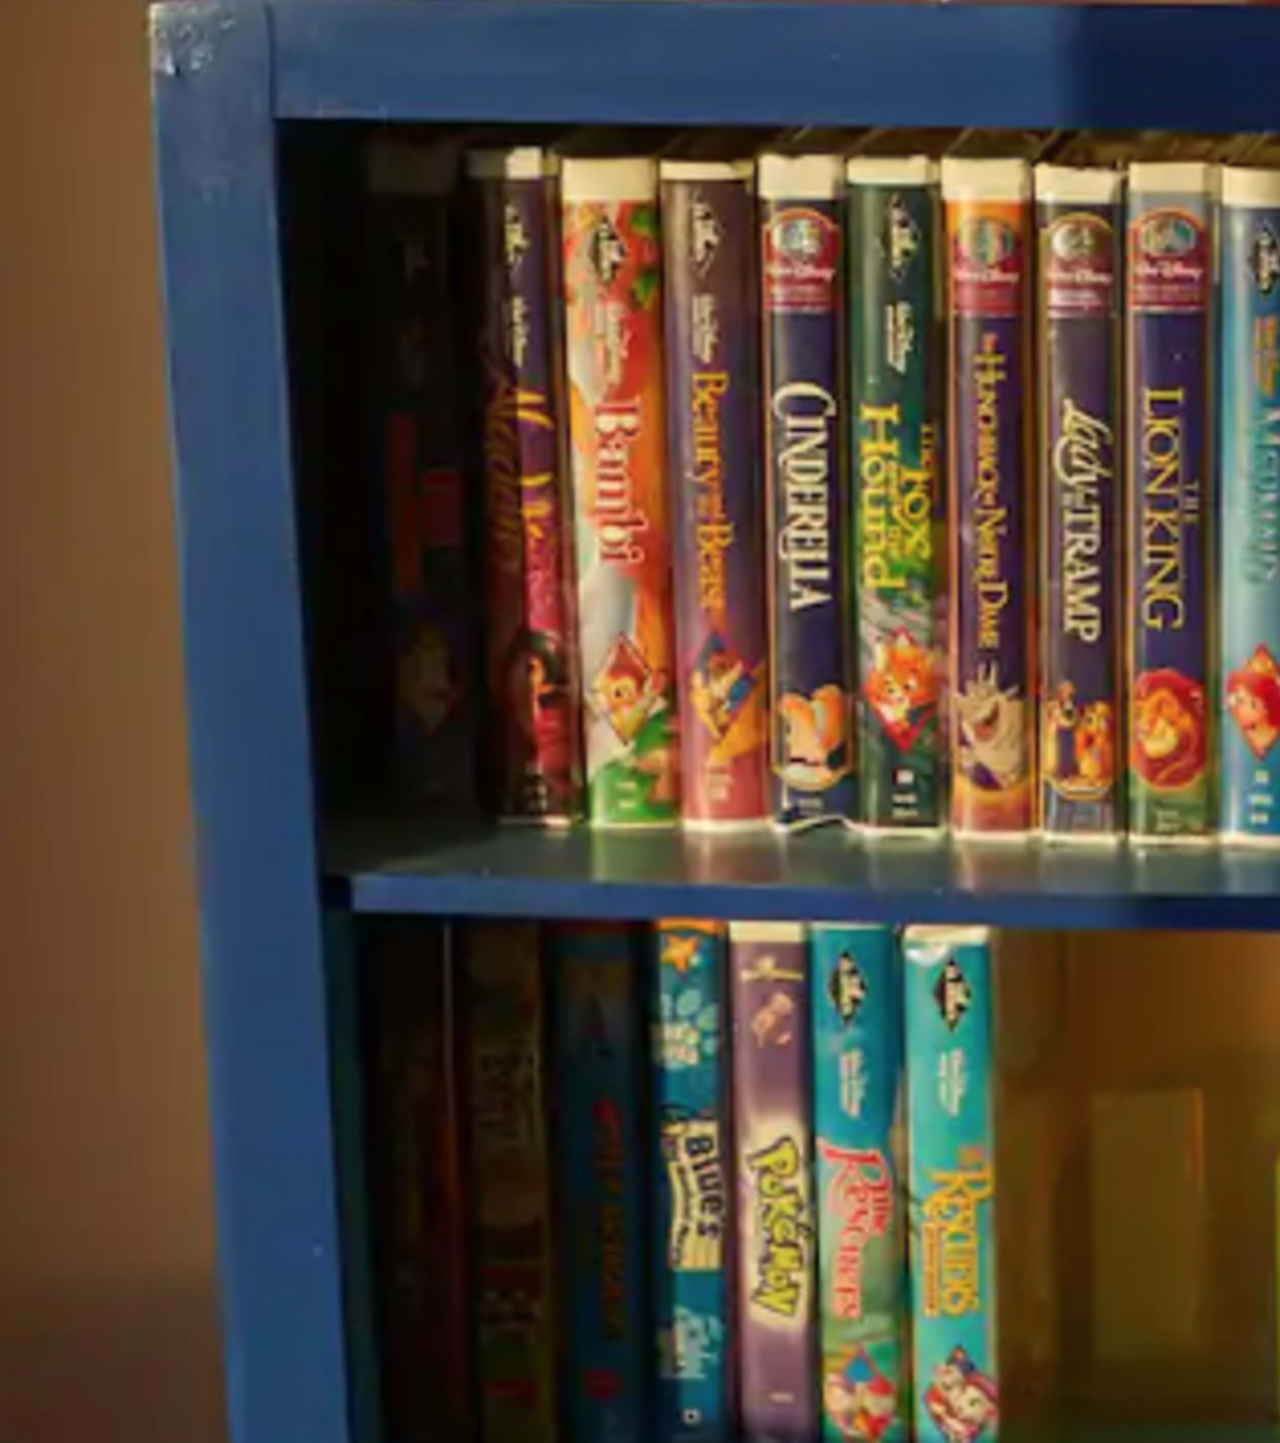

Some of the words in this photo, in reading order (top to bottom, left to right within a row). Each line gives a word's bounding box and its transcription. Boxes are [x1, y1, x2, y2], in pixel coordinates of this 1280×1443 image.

[594, 395, 650, 566] Bambi
[687, 369, 731, 483] Beauty
[1052, 397, 1116, 498] Lady
[1141, 385, 1186, 498] LION
[772, 380, 838, 612] CINDERELLA
[858, 400, 903, 590] Hound
[697, 522, 734, 613] Beast
[1062, 503, 1104, 642] TRAMP
[1140, 512, 1186, 631] KING
[687, 1134, 728, 1240] Blue's
